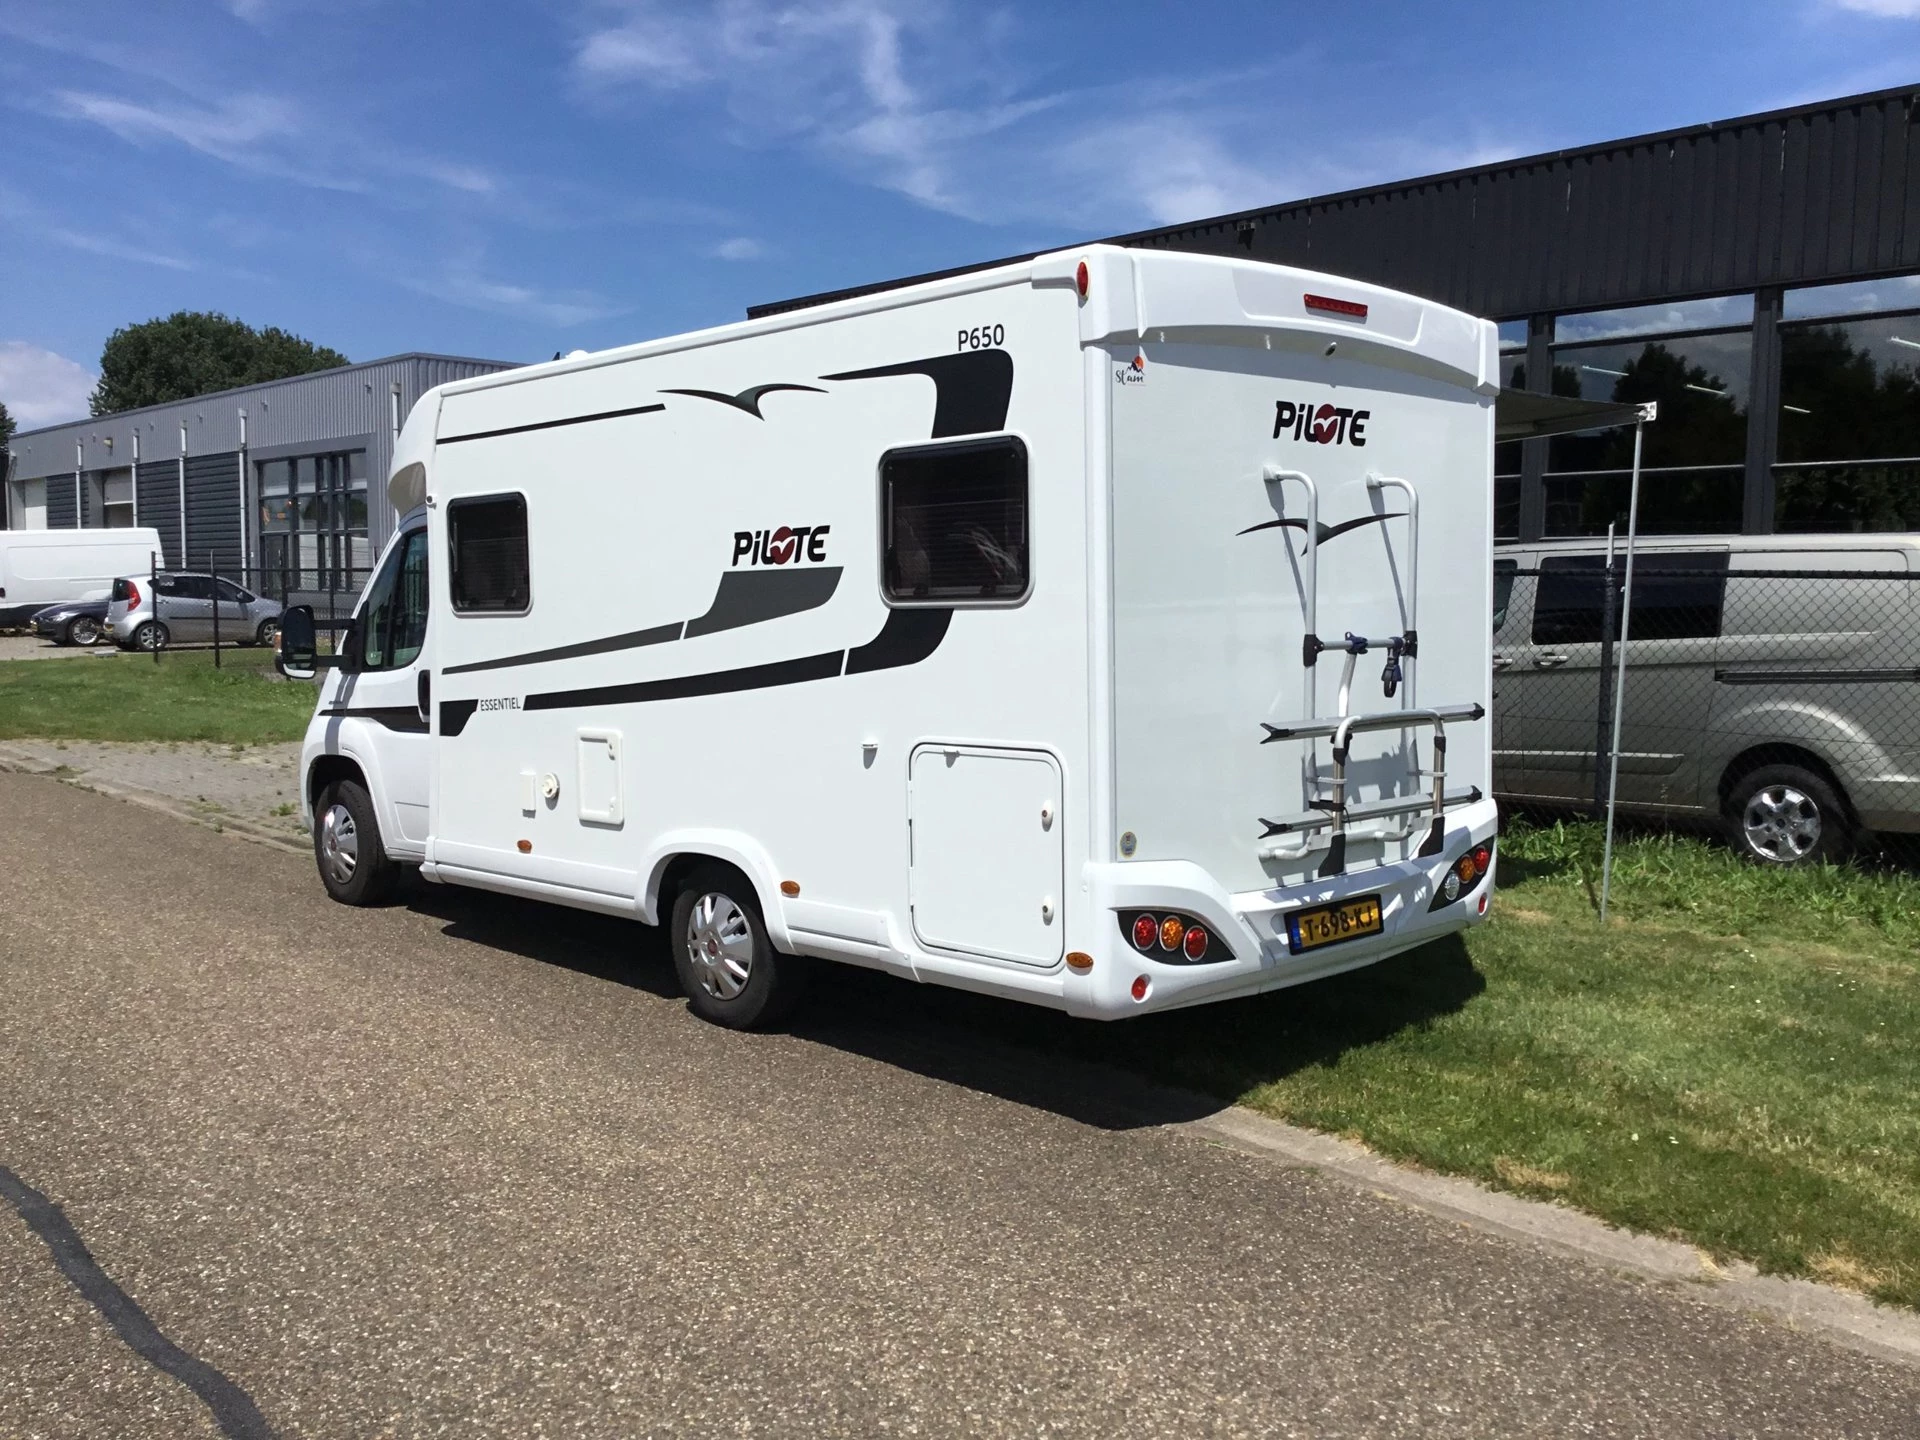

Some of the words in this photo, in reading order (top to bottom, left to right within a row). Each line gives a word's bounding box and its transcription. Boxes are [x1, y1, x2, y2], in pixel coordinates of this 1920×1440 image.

[958, 323, 1005, 351] P650
[1115, 369, 1144, 385] Stam
[480, 697, 521, 711] ESSENTIEL
[1304, 905, 1373, 941] T-698-KJ
